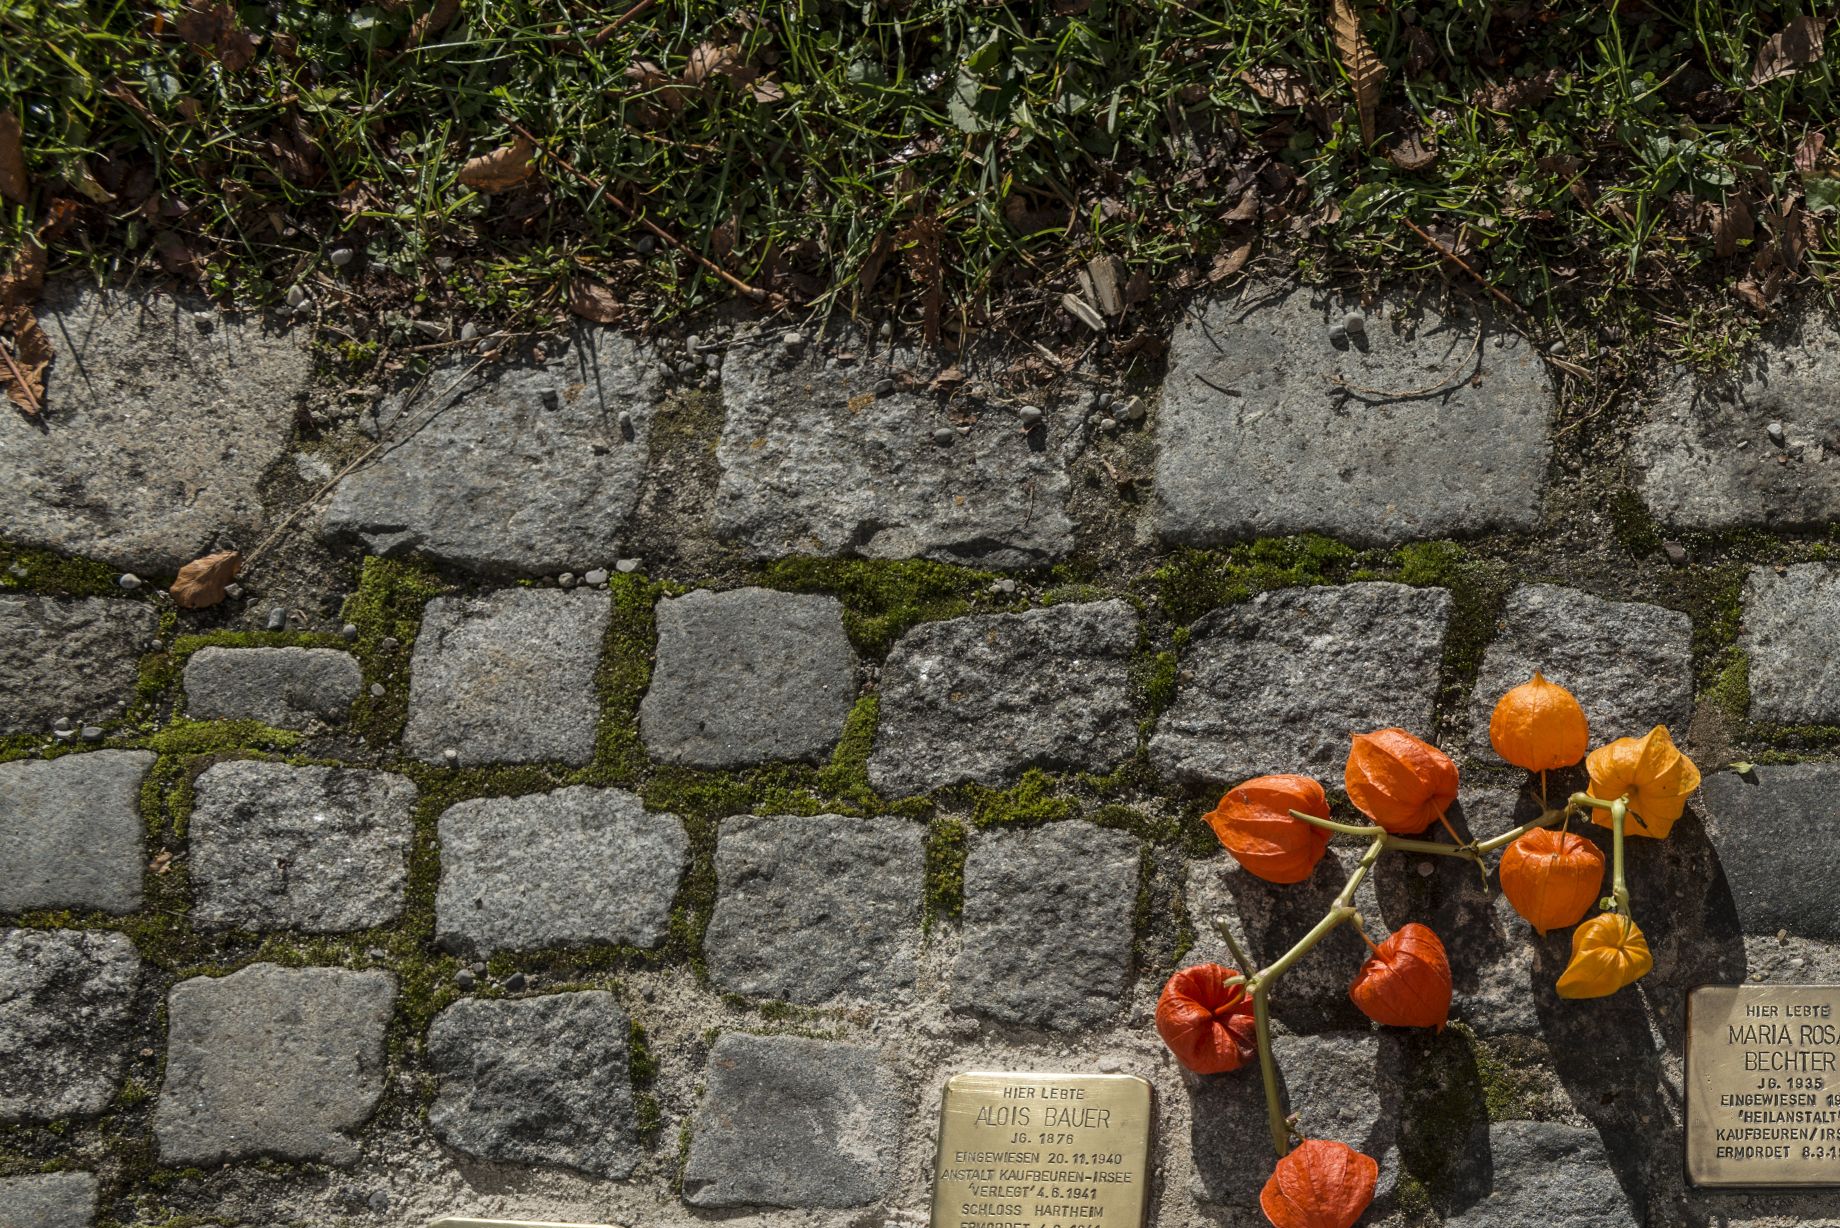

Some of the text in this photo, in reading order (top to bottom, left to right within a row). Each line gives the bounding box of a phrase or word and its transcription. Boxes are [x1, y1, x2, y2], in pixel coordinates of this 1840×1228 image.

[1746, 1005, 1831, 1017] HIER LEBTE
[1728, 1024, 1792, 1045] MARIA
[1745, 1051, 1836, 1072] BECHTER
[1757, 1078, 1823, 1090] JG. 1935
[1003, 1087, 1085, 1100] HIER LEBTE
[1721, 1094, 1816, 1106] EINGEWIESEN
[975, 1106, 1111, 1129] ALOIS BAUER
[1011, 1133, 1074, 1145] JG. 1876
[955, 1152, 1039, 1164] EINGEWIESEN
[1716, 1146, 1790, 1159] ERMORDET
[941, 1169, 1132, 1183] ANSTALT KAUFBEUREN-IRSEE
[962, 1204, 1103, 1218] SCHLOSS HARTHEIM
